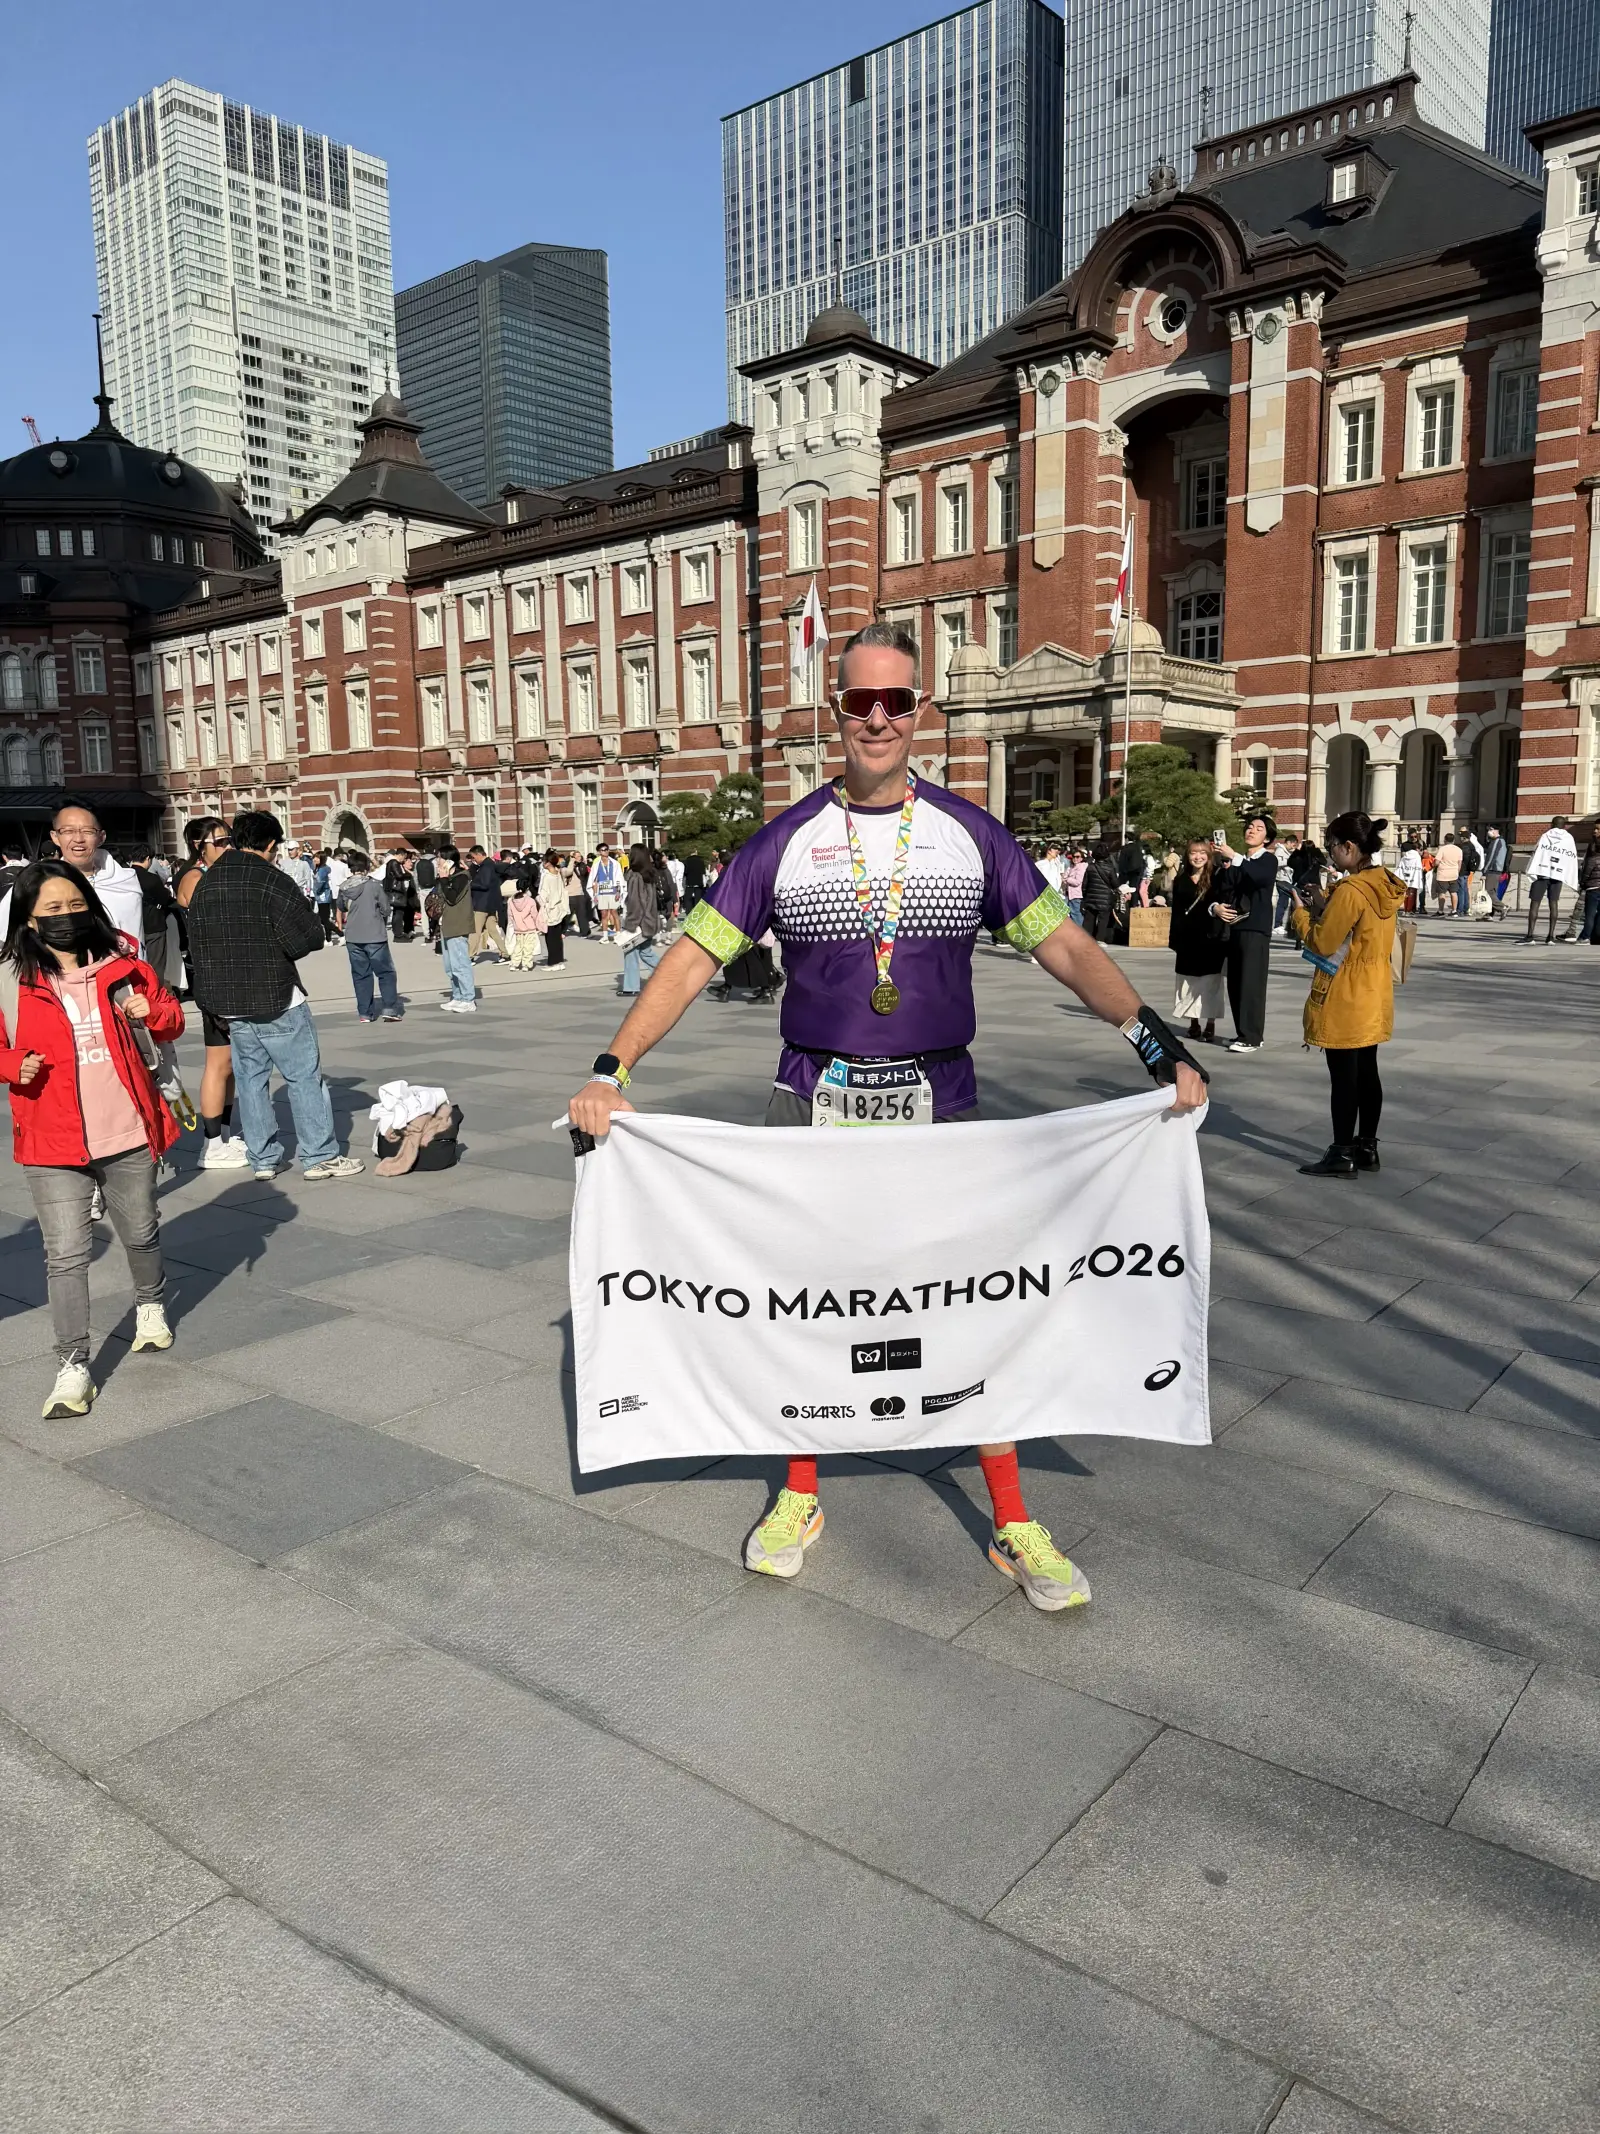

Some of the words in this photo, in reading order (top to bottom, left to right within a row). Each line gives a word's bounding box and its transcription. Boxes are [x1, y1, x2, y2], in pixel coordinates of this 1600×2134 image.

[811, 846, 832, 855] Blood
[811, 853, 836, 862] United
[812, 862, 832, 870] Team
[852, 1069, 917, 1085] 東京メトロ
[816, 1092, 831, 1108] G
[843, 1093, 915, 1121] 18256
[819, 1116, 828, 1126] 2
[597, 1269, 750, 1319] TOKYO
[768, 1264, 1050, 1321] MARATHON
[1065, 1242, 1186, 1285] 2026
[924, 1396, 957, 1405] POCARI
